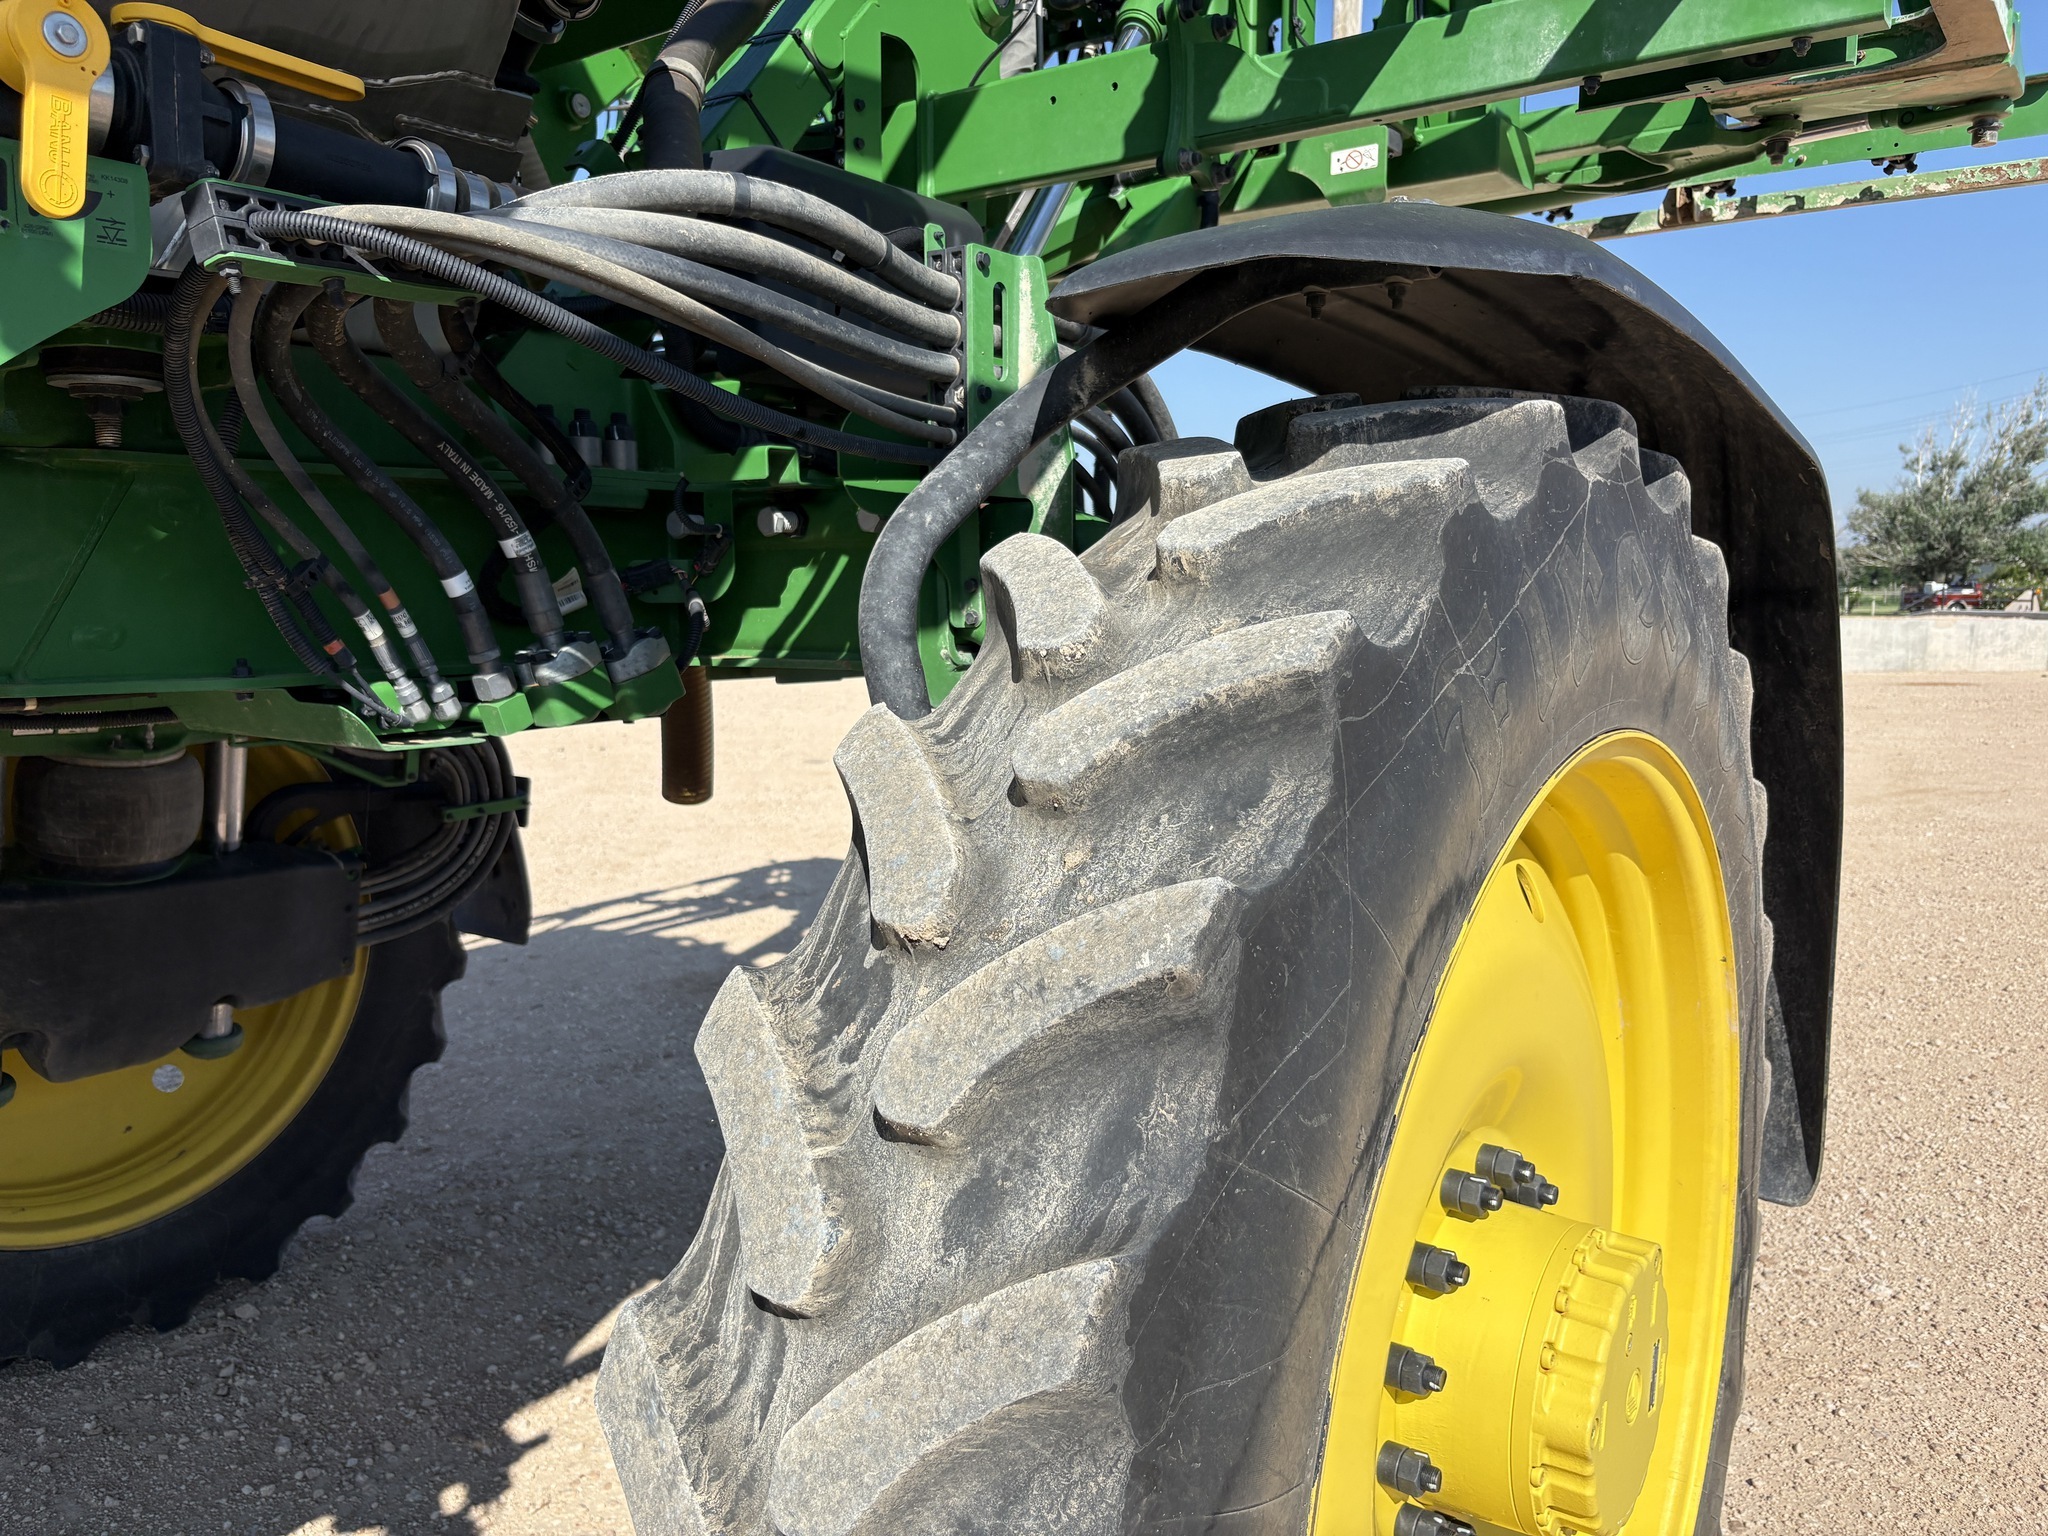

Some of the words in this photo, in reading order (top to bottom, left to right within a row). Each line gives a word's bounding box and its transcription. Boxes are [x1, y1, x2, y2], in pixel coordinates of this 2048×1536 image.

[437, 441, 463, 466] ITALY
[459, 462, 472, 476] IN
[469, 471, 495, 500] MADE
